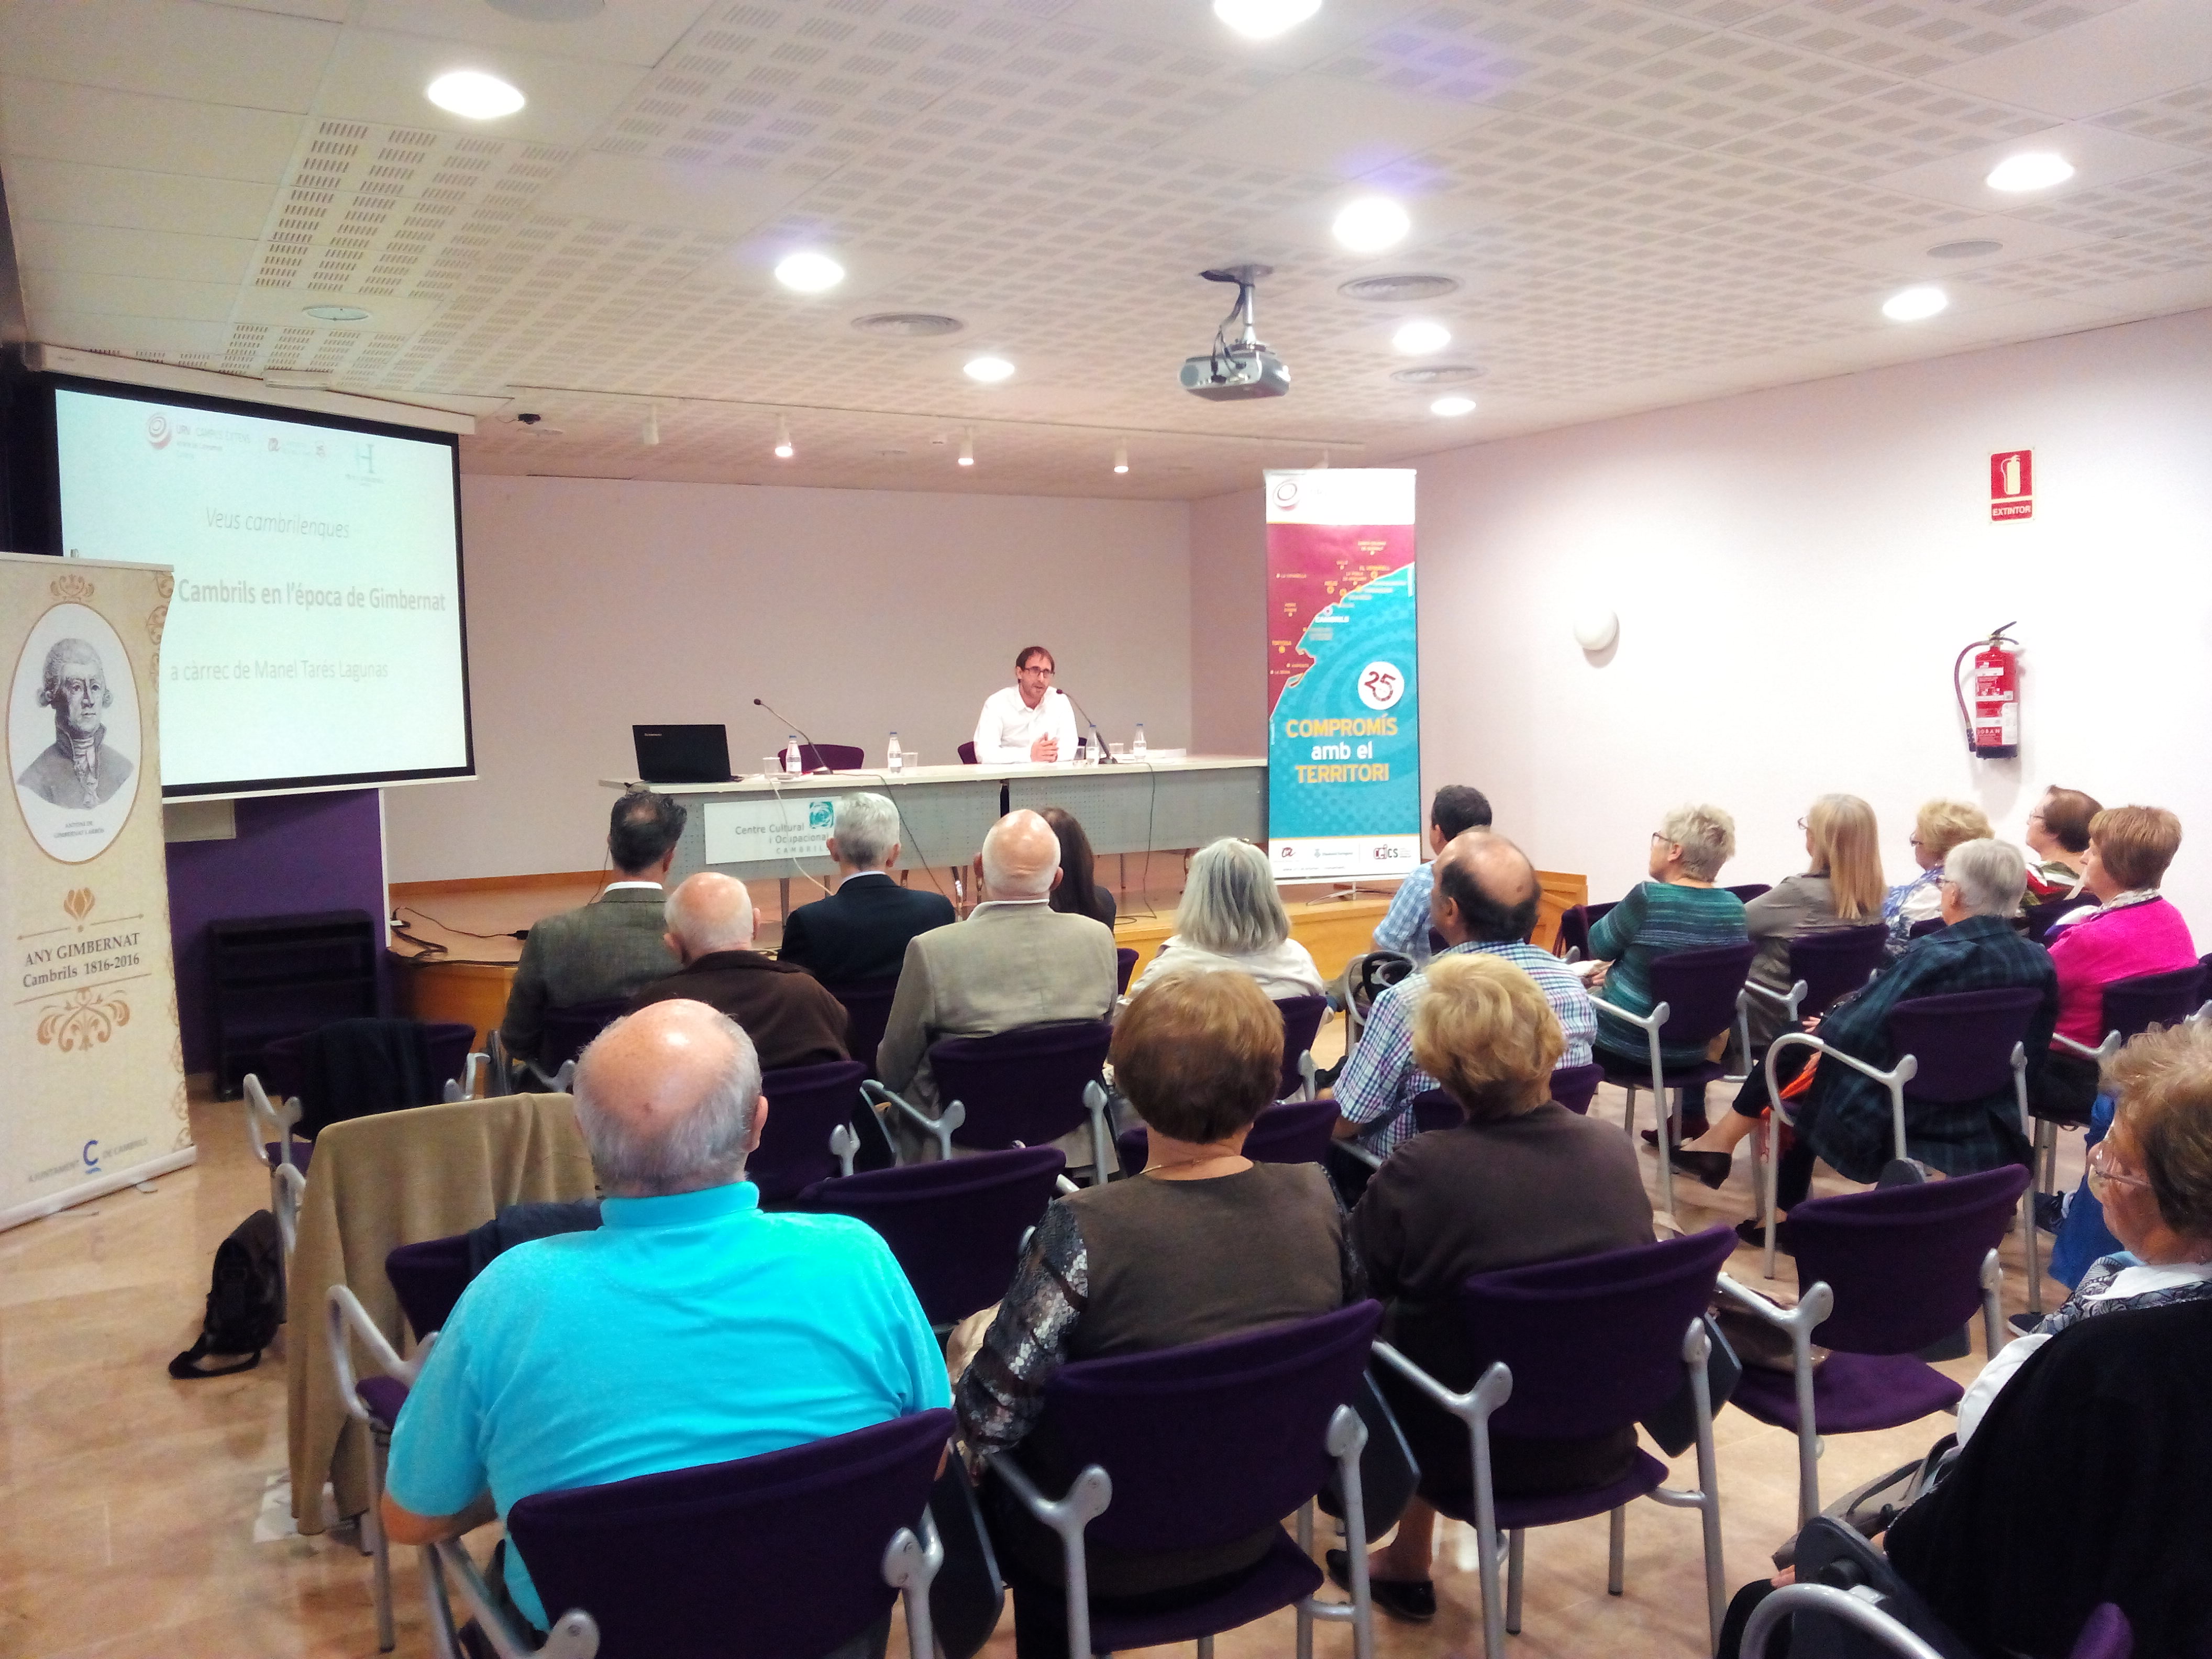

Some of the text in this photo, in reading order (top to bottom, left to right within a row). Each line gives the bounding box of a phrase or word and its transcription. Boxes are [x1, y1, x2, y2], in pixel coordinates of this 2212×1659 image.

[206, 506, 240, 529] Veus
[1993, 505, 2031, 516] EXTINTOR
[178, 579, 256, 604] Cambrils
[261, 585, 282, 604] en
[347, 587, 365, 609] de
[369, 587, 446, 611] Gimbernat
[170, 665, 179, 681] a
[183, 661, 229, 681] càrrec
[234, 660, 250, 679] de
[255, 660, 297, 680] Manel
[339, 660, 389, 682] Lagunas
[1364, 671, 1397, 702] 25
[1286, 713, 1398, 738] COMPROMÍS
[1311, 741, 1373, 760] amb el
[1295, 764, 1390, 783] TERRITORI
[735, 826, 766, 835] Centre
[25, 932, 140, 967] ANY GIMBERNAT
[23, 953, 140, 988] Cambrils 1816-2016
